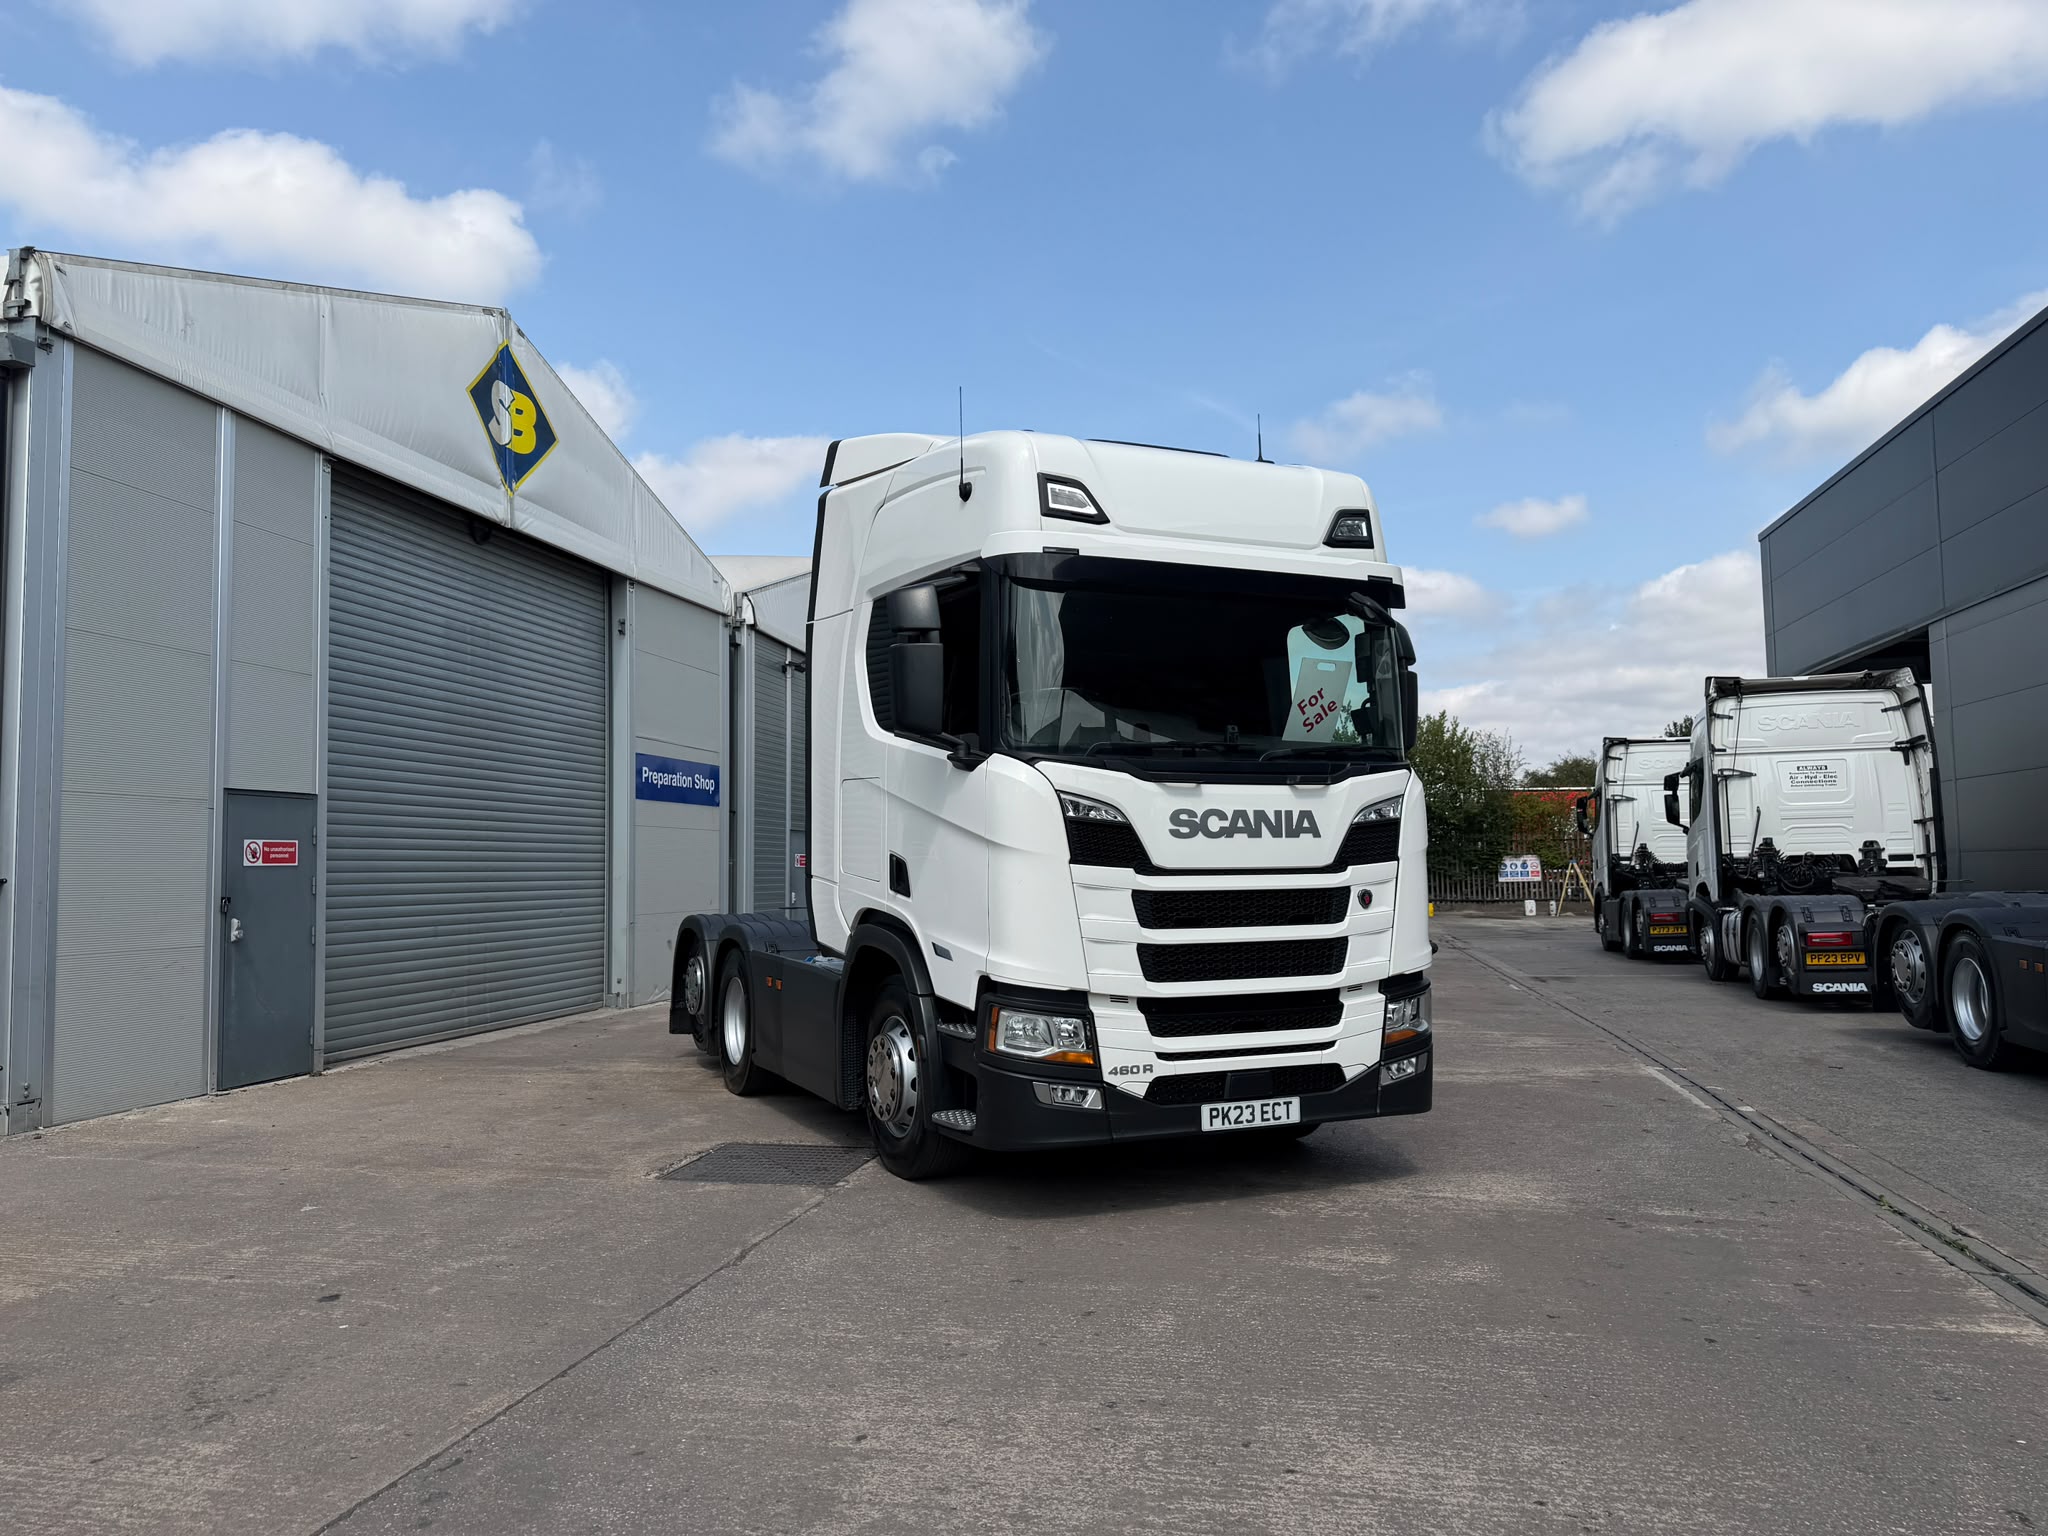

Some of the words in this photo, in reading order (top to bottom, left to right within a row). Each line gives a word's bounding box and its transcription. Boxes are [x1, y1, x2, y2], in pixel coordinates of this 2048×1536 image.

[1297, 687, 1325, 716] For
[1302, 700, 1338, 733] Sale
[1758, 712, 1861, 732] SCANIA
[642, 766, 693, 788] Preparation
[694, 774, 715, 794] Shop
[1164, 808, 1322, 839] SCANIA
[1810, 954, 1838, 963] PF23
[1812, 982, 1868, 992] SCANIA
[1108, 1065, 1139, 1076] 460
[1142, 1064, 1154, 1074] R
[1209, 1104, 1256, 1127] PK23
[1260, 1100, 1293, 1122] ECT
